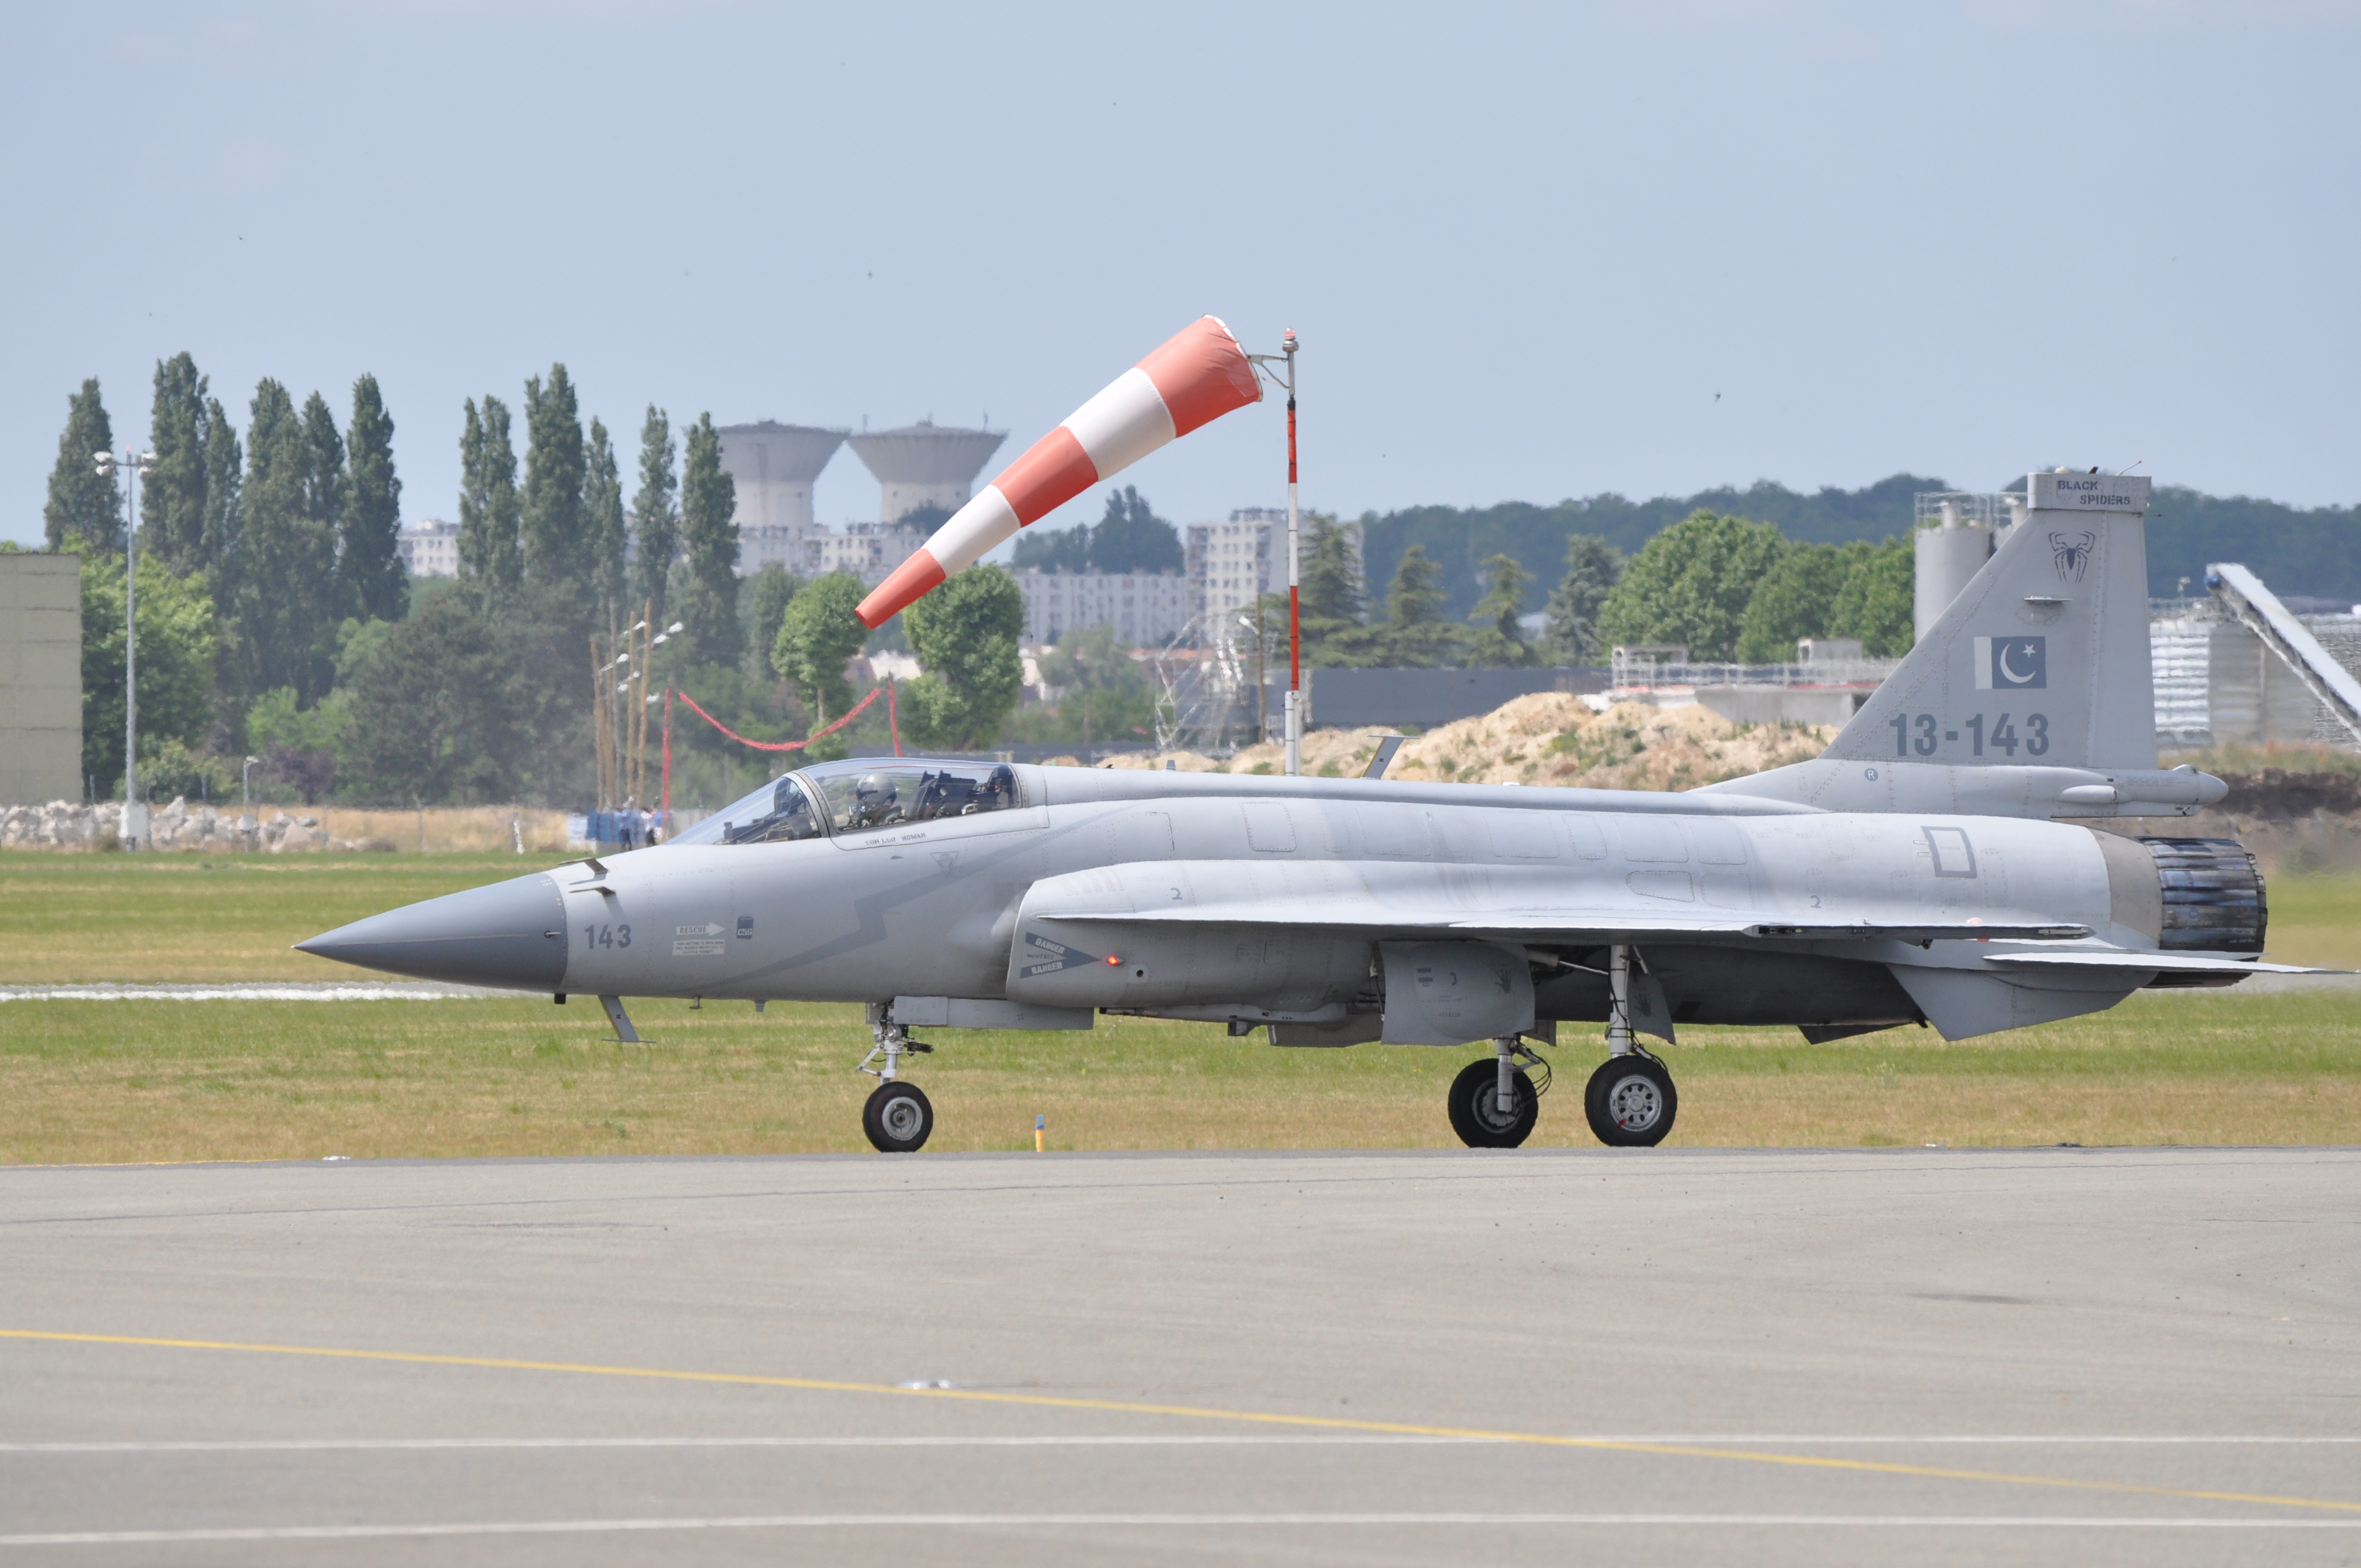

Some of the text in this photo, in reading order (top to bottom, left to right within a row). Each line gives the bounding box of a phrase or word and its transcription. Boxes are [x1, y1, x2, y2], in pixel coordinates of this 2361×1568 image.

[2057, 480, 2099, 491] BLACK
[2080, 494, 2131, 505] SPIDERS
[1889, 713, 2049, 757] 13-143
[1170, 888, 1183, 900] 2
[1810, 895, 1821, 908] 2
[584, 924, 632, 949] 143
[1035, 938, 1065, 954] DANGER
[1031, 961, 1063, 974] DANGER
